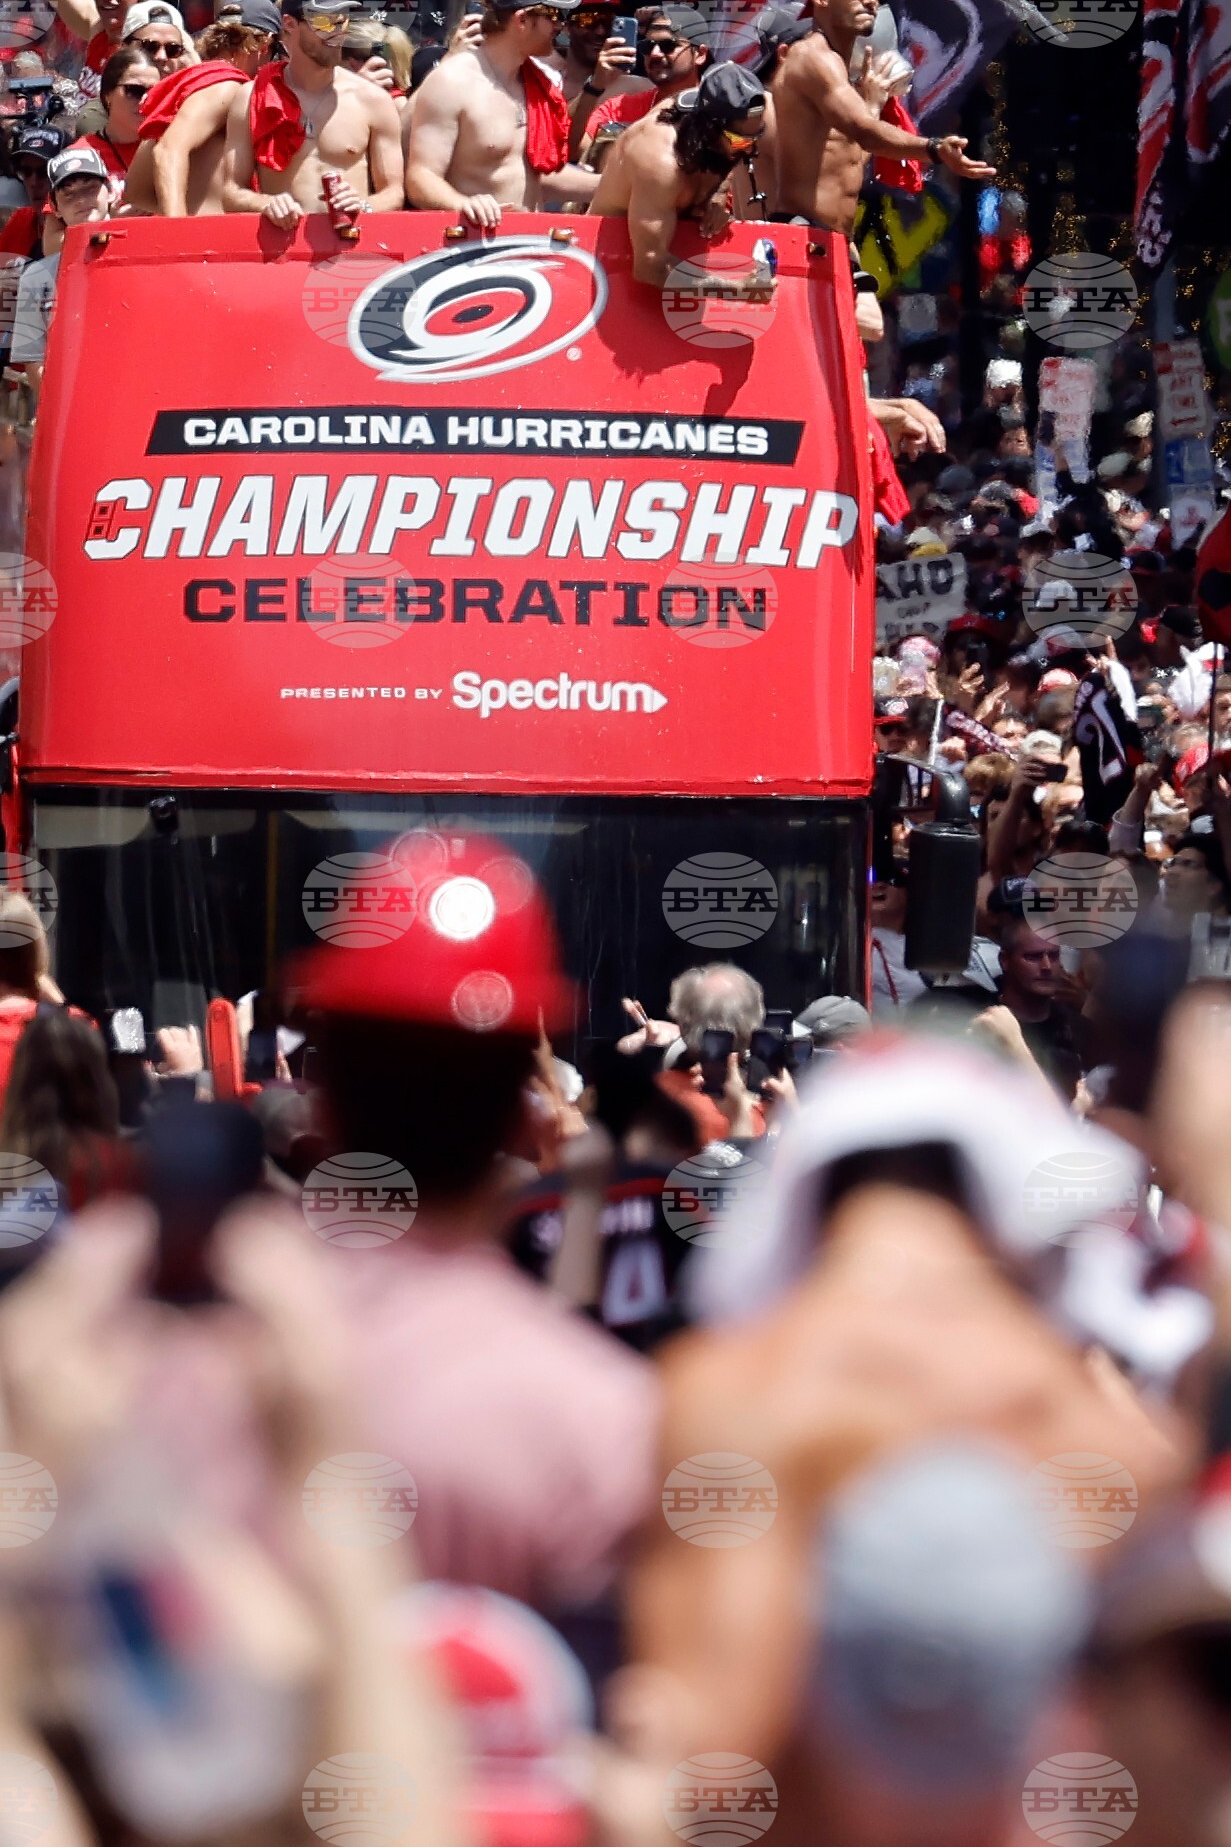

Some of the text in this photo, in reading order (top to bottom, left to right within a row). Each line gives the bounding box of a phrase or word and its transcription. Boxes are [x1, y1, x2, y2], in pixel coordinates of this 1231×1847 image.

[183, 415, 769, 456] CAROLINA HURRICANES
[83, 474, 859, 569] CHAMPIONSHIP
[183, 578, 767, 632] CELEBRATION
[279, 686, 443, 700] PRESENTED BY
[452, 670, 656, 719] Spectrum
